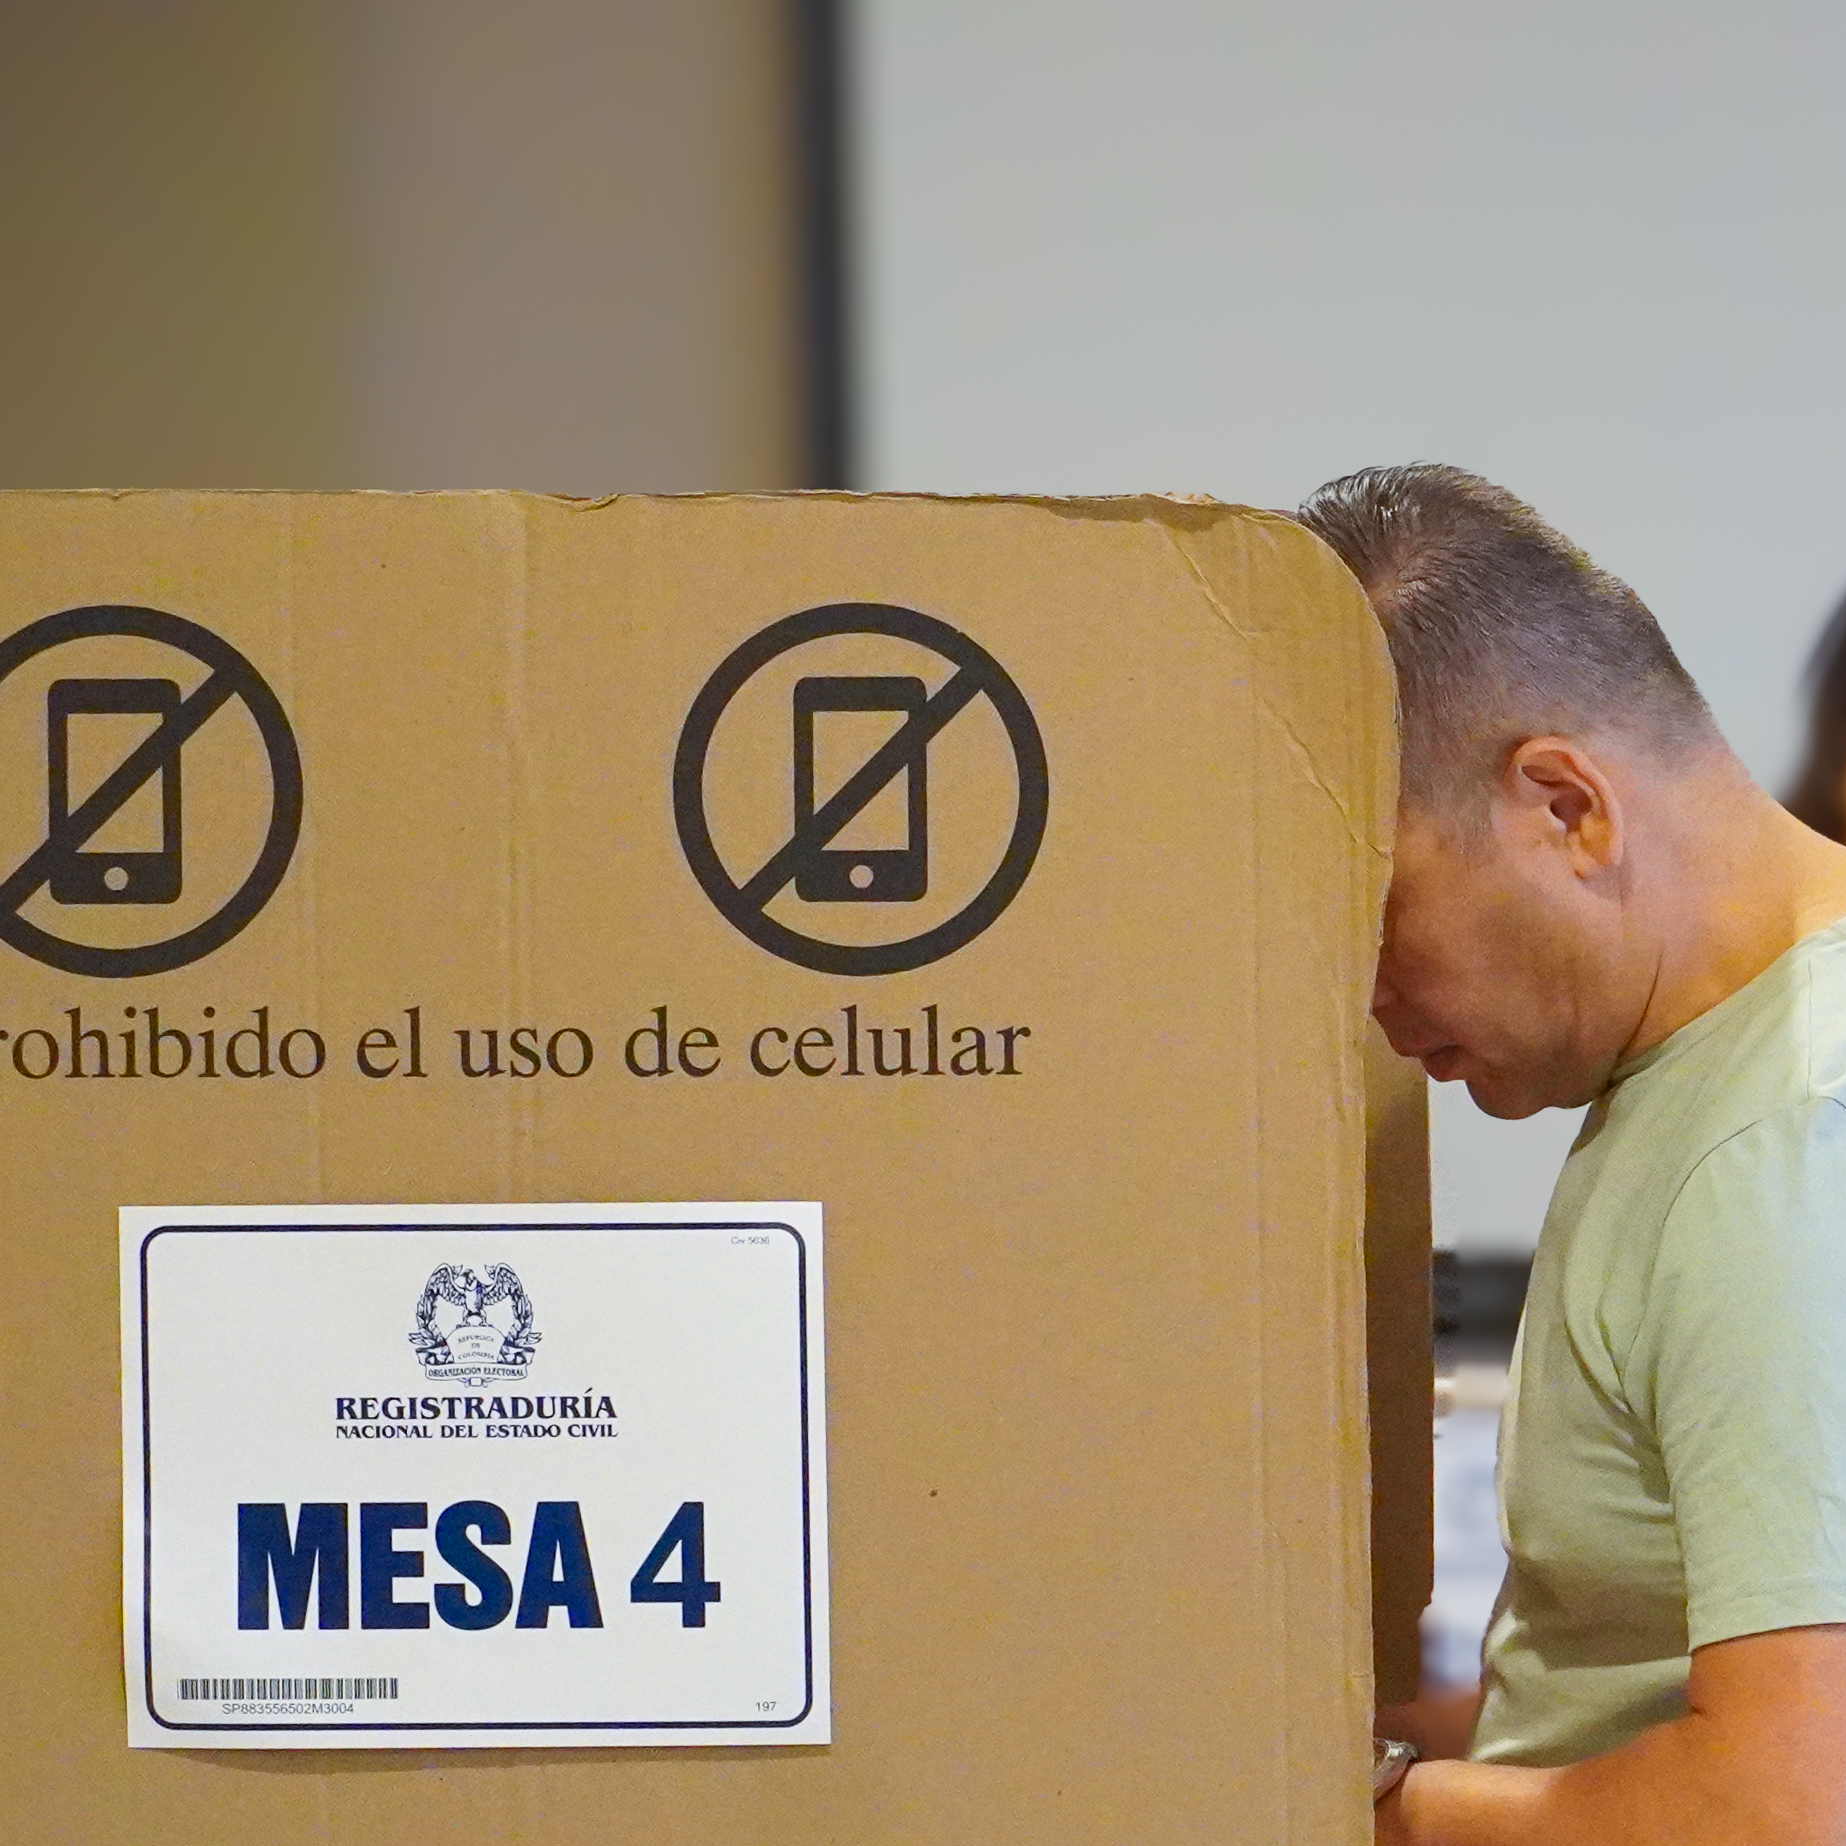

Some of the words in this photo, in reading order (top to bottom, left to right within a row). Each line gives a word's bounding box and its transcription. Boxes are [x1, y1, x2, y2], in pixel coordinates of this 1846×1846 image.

[0, 1006, 326, 1079] ohibido
[357, 1006, 427, 1078] el
[454, 1028, 593, 1078] uso
[625, 1005, 720, 1077] de
[750, 1004, 1031, 1077] celular
[336, 1387, 618, 1420] REGISTRADURÍA
[336, 1424, 433, 1439] NACIONAL
[440, 1424, 479, 1438] DEL
[486, 1424, 562, 1438] ESTADO
[567, 1424, 618, 1438] CIVIL
[238, 1500, 603, 1631] MESA
[630, 1501, 721, 1628] 4
[755, 1701, 777, 1712] 197
